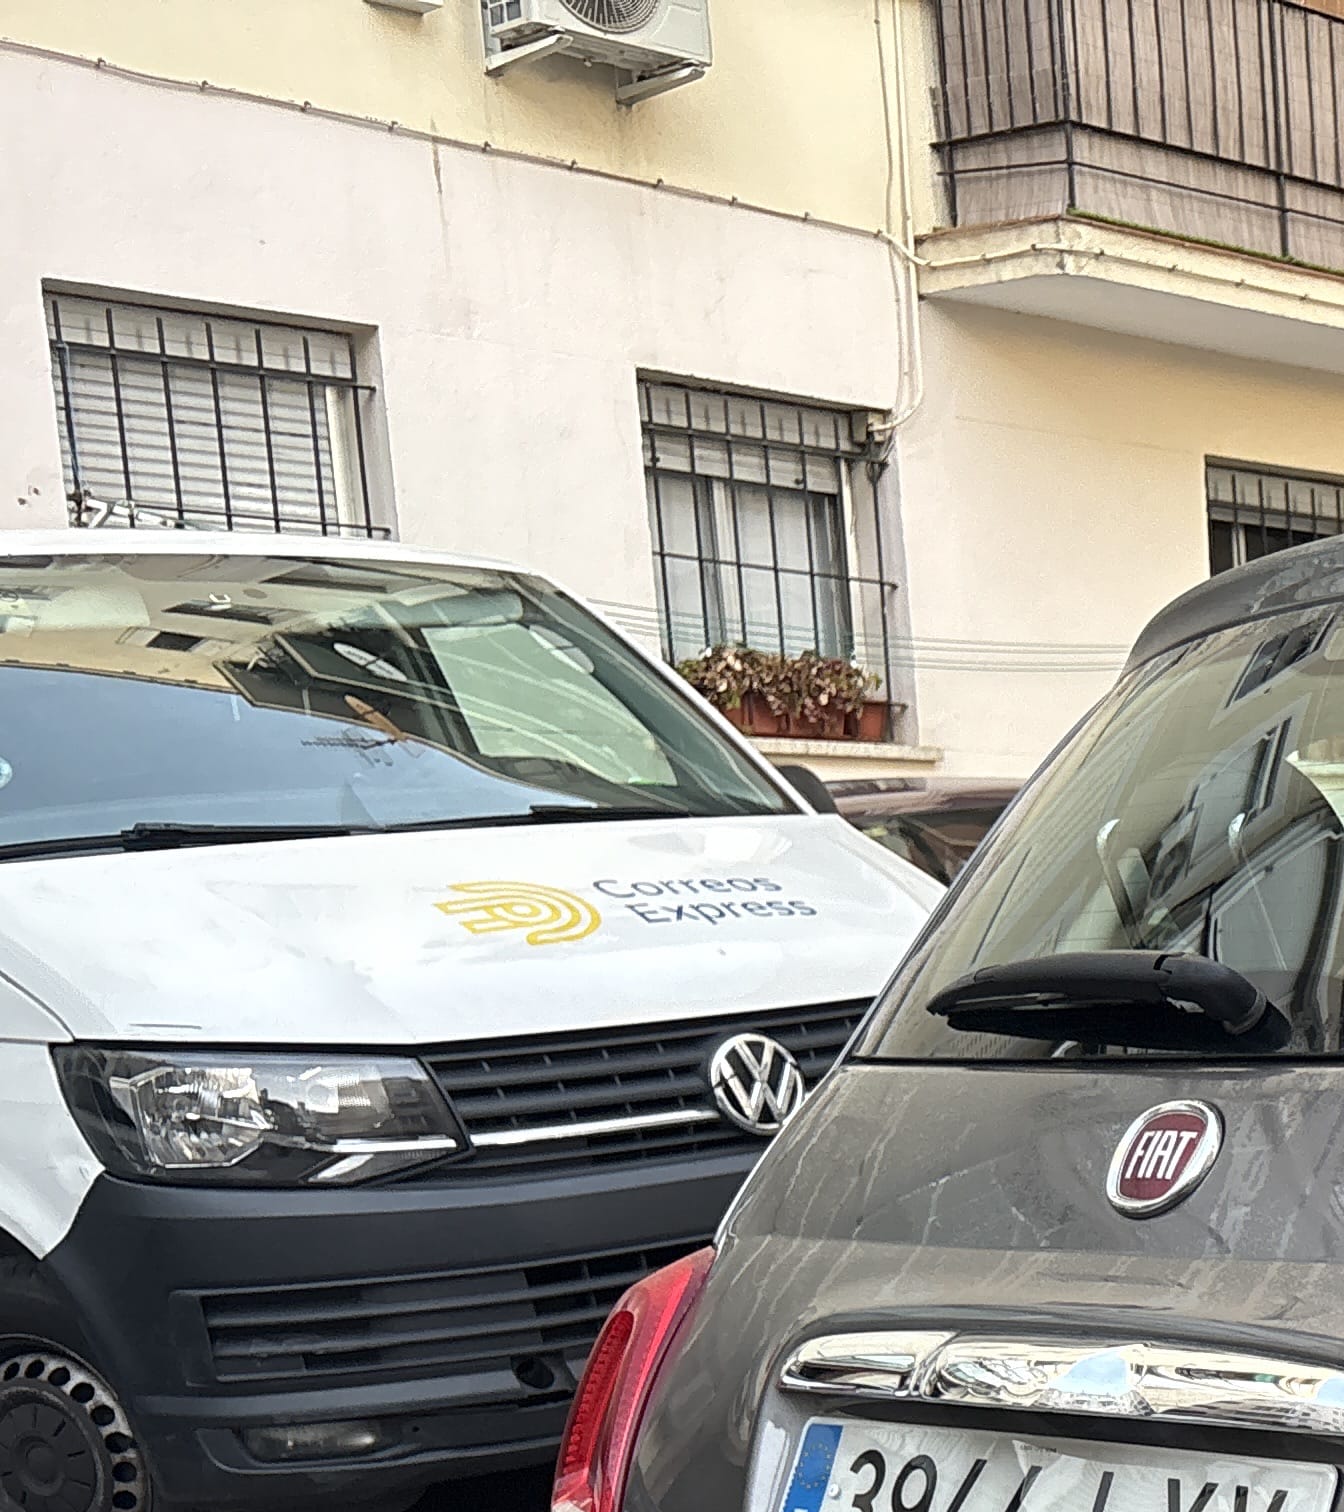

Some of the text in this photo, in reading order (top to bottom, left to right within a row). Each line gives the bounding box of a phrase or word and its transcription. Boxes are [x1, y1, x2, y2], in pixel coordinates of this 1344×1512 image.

[593, 878, 782, 898] Correos
[625, 900, 817, 925] Express
[1124, 1130, 1198, 1180] FIAT
